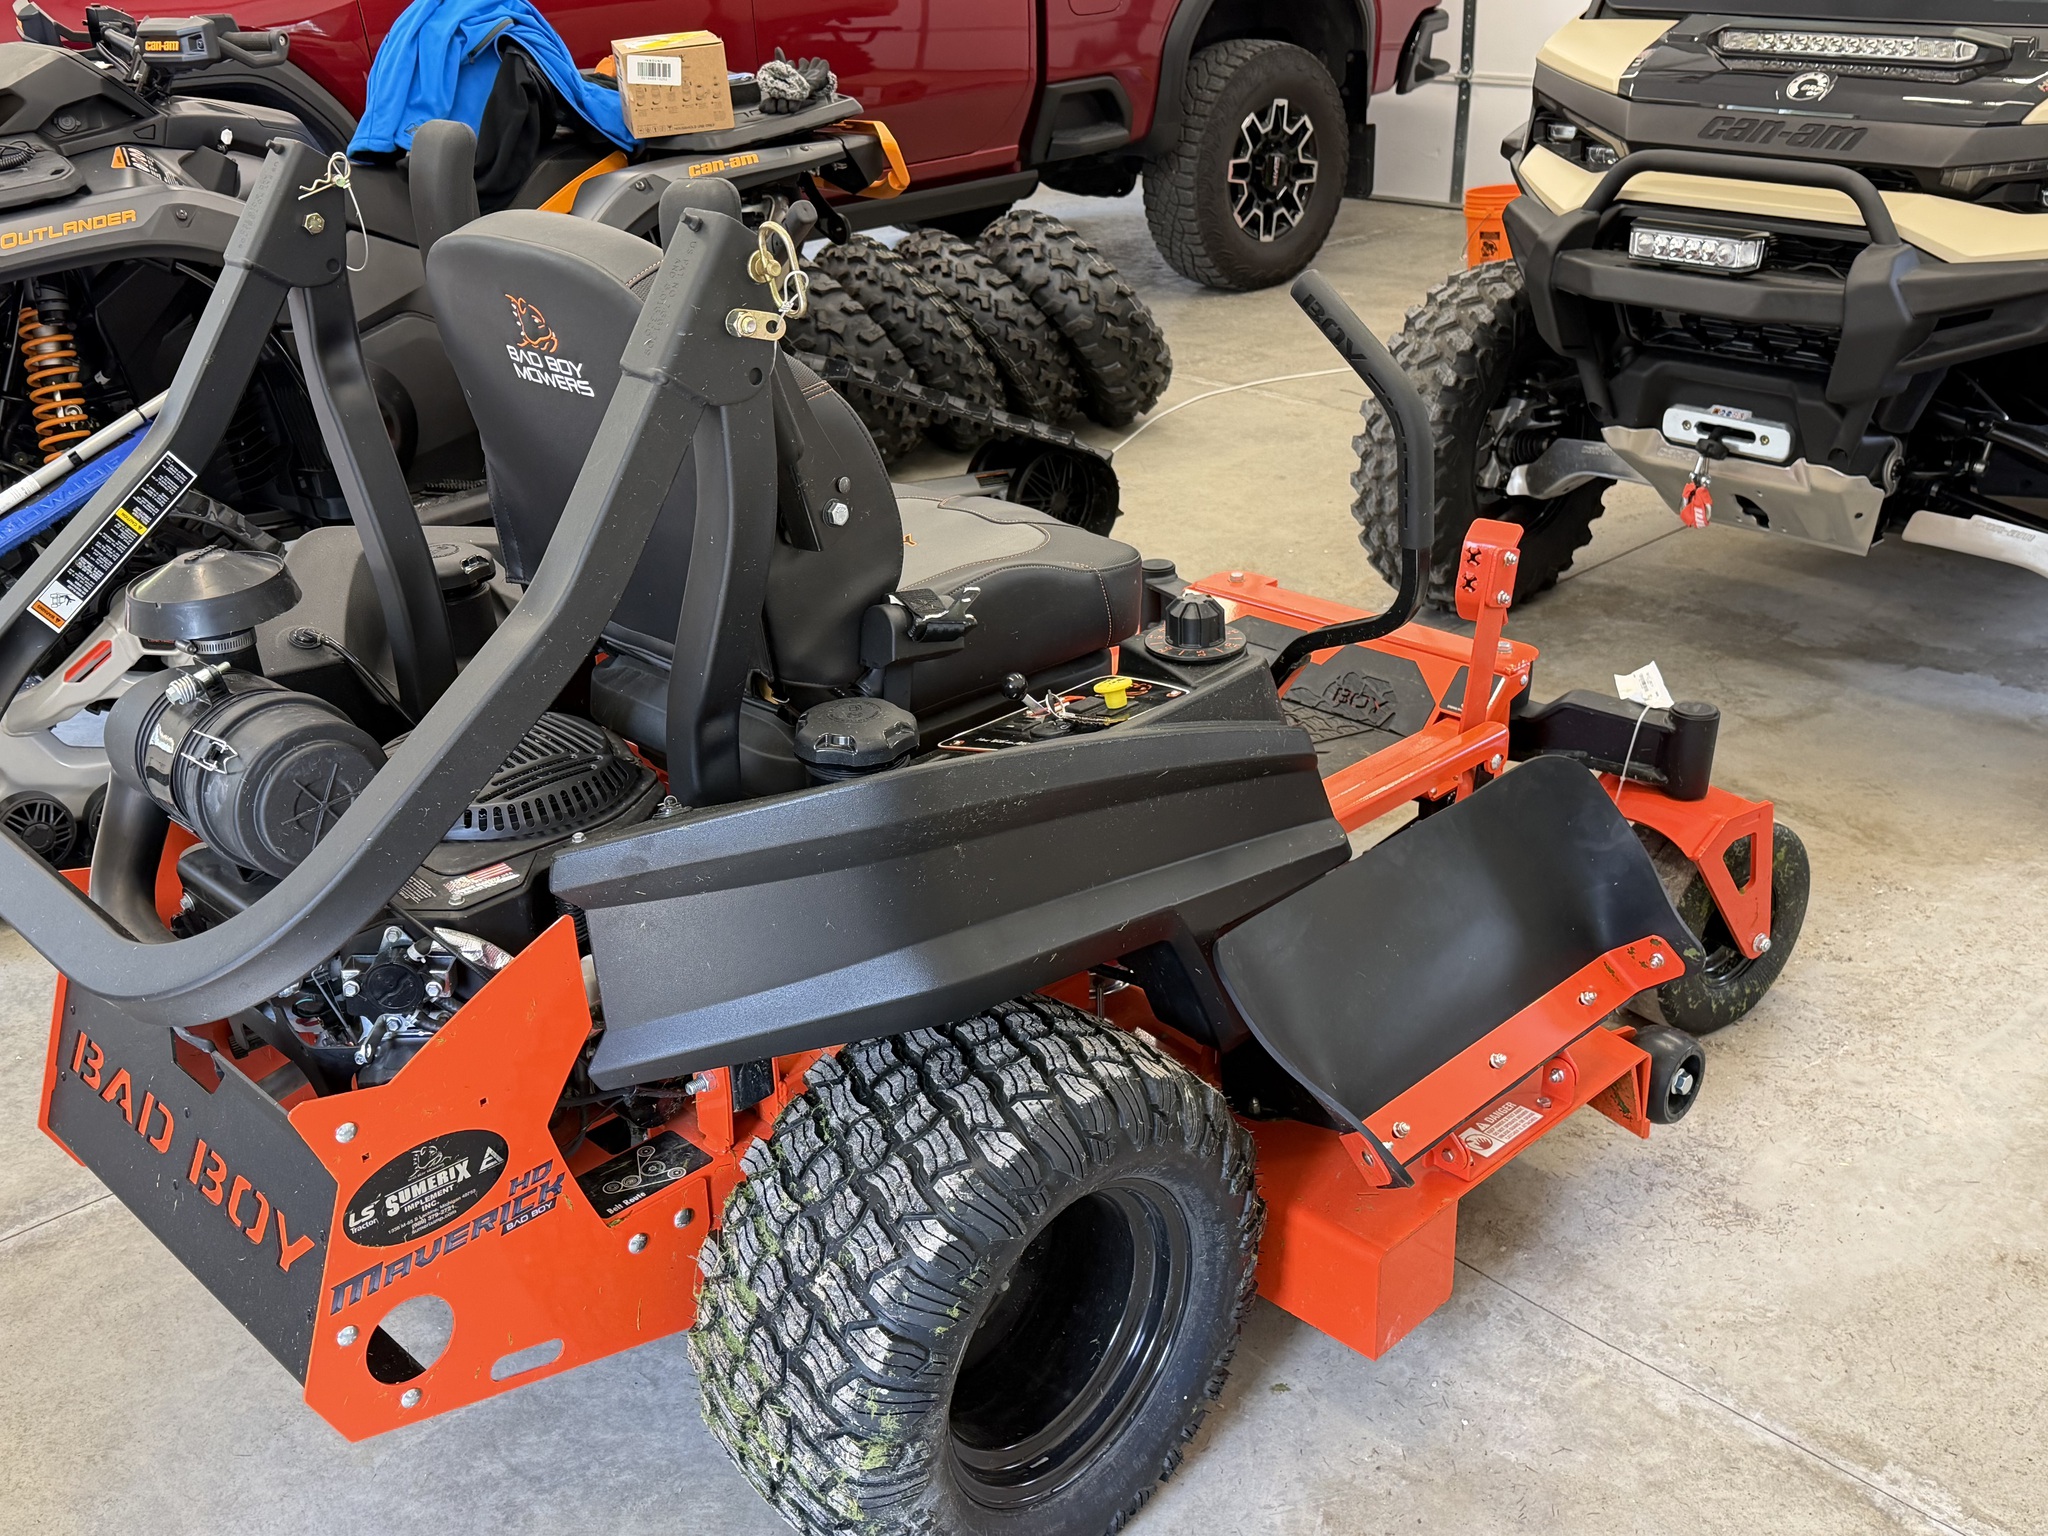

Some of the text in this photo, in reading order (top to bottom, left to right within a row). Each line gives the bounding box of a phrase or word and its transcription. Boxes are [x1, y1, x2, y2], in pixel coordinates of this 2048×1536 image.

[145, 41, 179, 51] can-am
[1697, 115, 1869, 150] can-am
[689, 153, 759, 178] can-am
[1, 209, 137, 249] OUTLANDER
[1301, 293, 1367, 360] BOY
[506, 344, 583, 379] BAD BOY
[512, 362, 595, 398] MOWERS
[120, 511, 138, 527] CAUTION
[1333, 687, 1389, 713] BOY
[1484, 1101, 1517, 1124] DANGER
[71, 1031, 316, 1274] BAD BOY
[385, 1157, 472, 1217] SUMERIX
[508, 1158, 554, 1197] HD
[404, 1184, 454, 1213] IMPLEMENT
[422, 1201, 440, 1212] INC.
[439, 1196, 462, 1210] Michigan
[606, 1191, 647, 1215] Belt Route
[348, 1204, 376, 1227] LS
[350, 1219, 378, 1234] Tractor
[506, 1202, 554, 1231] BAD BOY
[330, 1172, 566, 1316] MAVERICK
